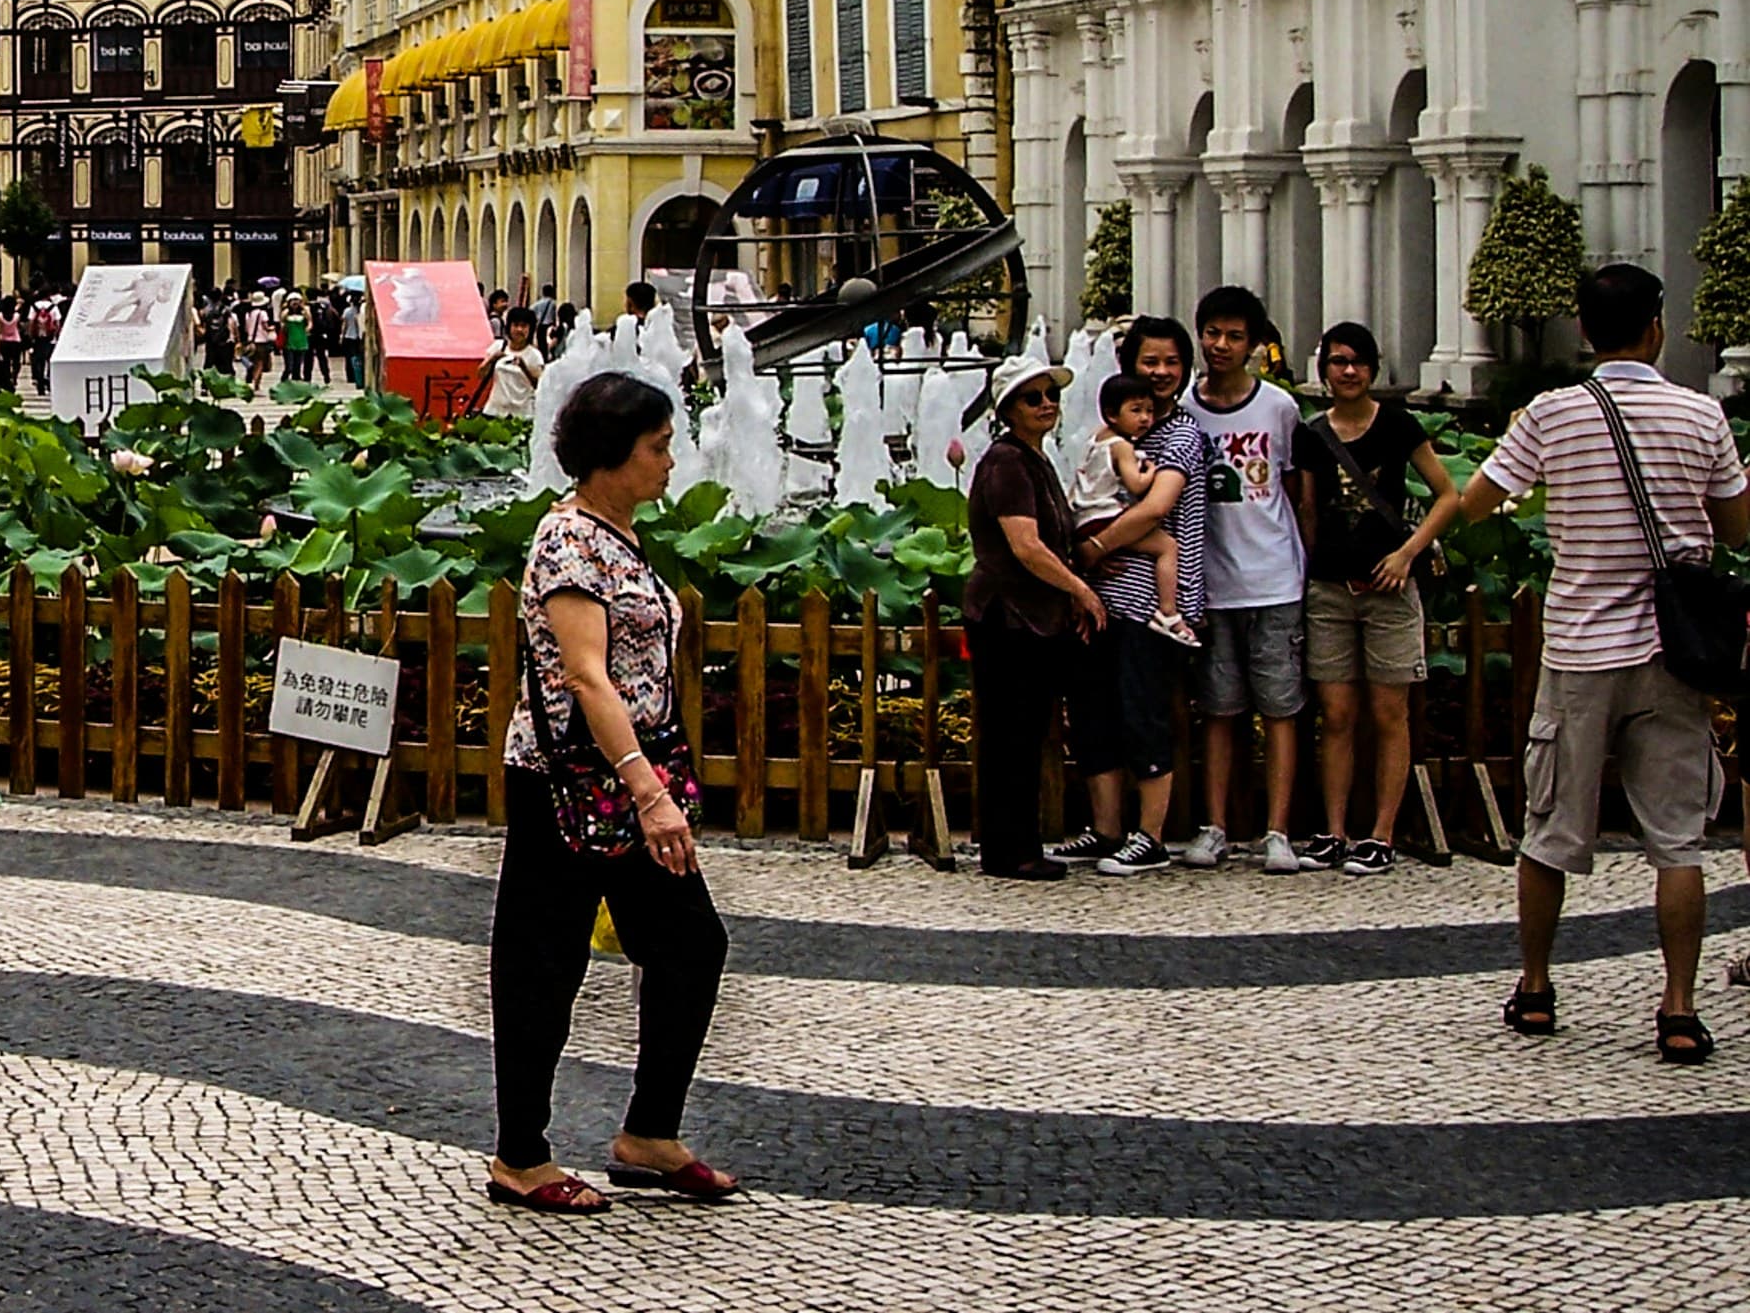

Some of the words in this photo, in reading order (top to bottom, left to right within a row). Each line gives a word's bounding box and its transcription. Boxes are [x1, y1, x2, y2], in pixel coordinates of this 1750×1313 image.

[90, 230, 131, 240] bauhaus
[163, 231, 205, 240] bauhaus
[234, 231, 278, 240] bauhaus
[85, 374, 129, 422] 明
[420, 369, 471, 421] 序
[282, 667, 388, 707] 為免發生危險
[295, 695, 368, 728] 請勿攀爬
